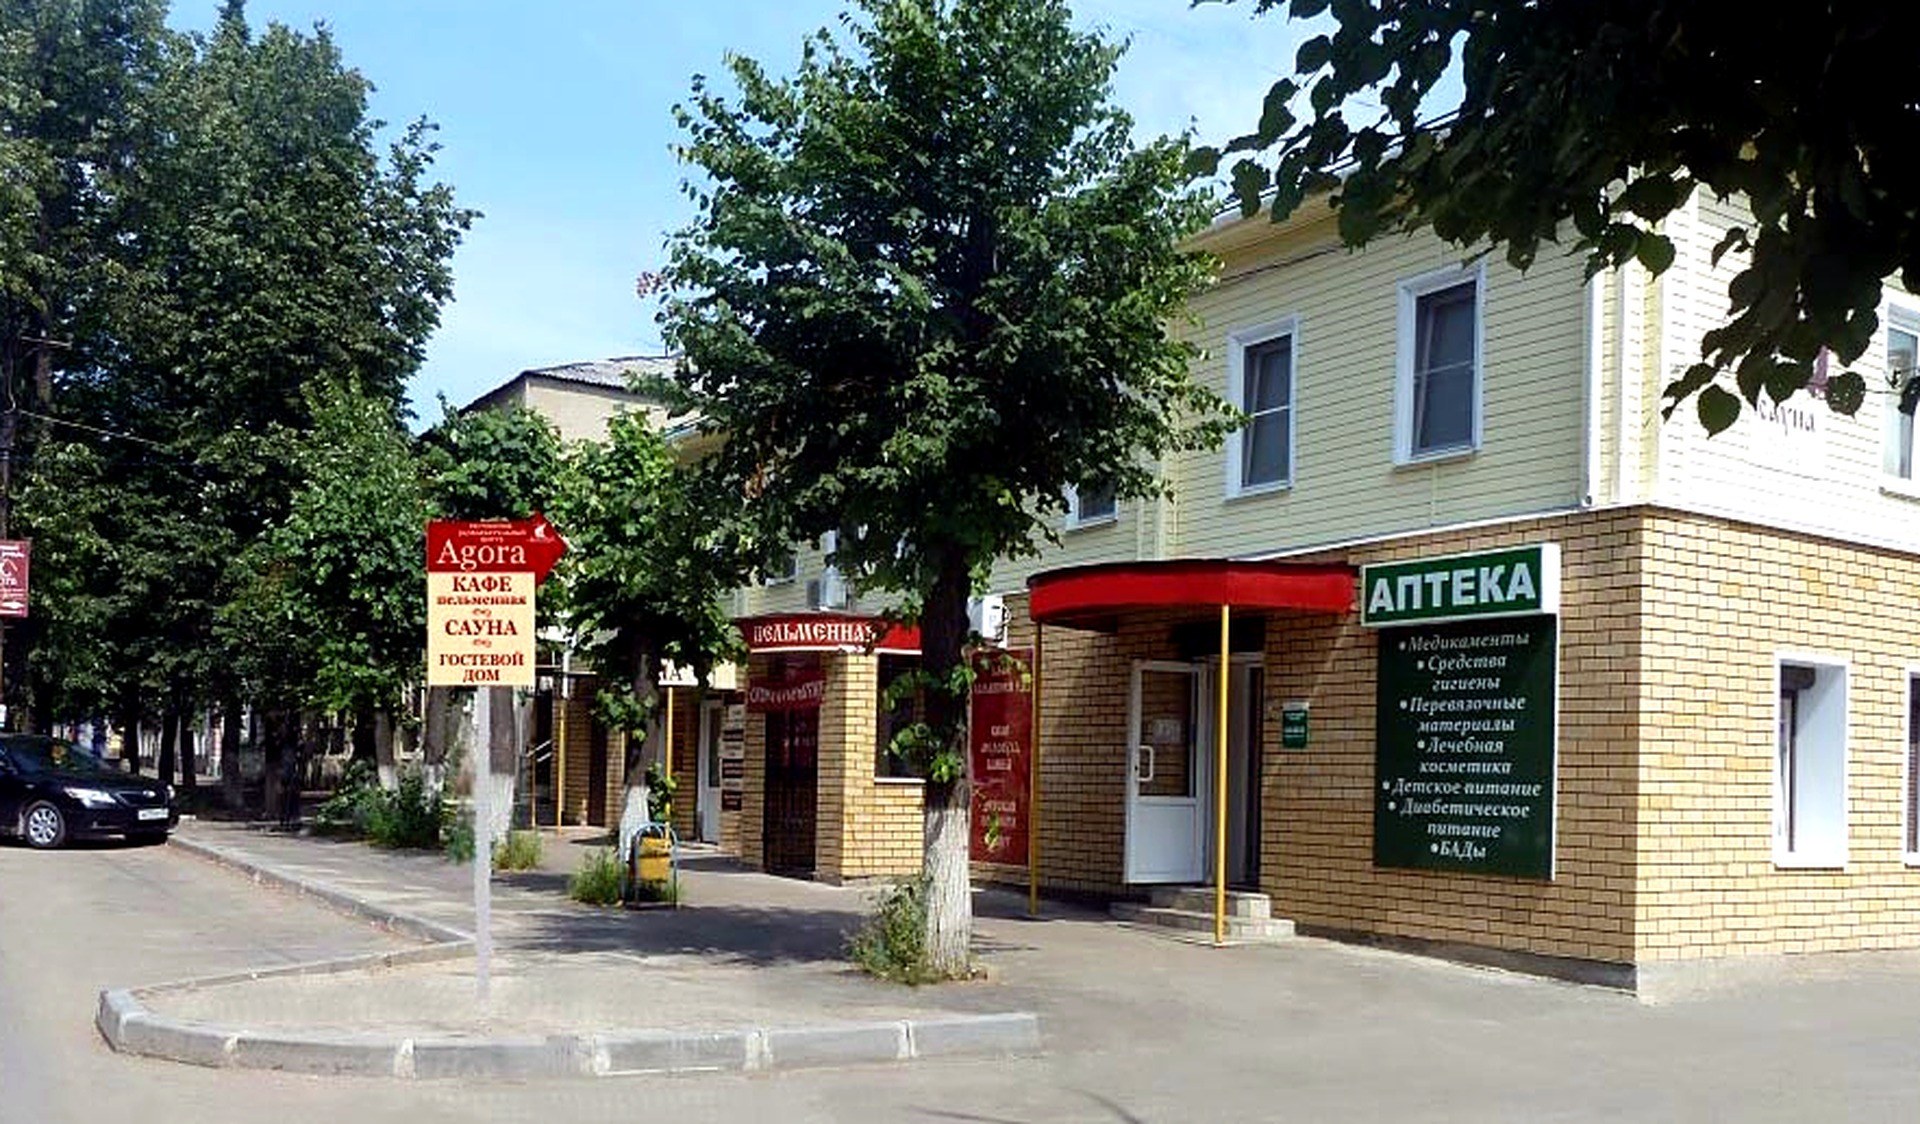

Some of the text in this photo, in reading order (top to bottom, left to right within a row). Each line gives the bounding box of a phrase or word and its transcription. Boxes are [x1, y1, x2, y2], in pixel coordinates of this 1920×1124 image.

[436, 538, 527, 572] Agora
[452, 575, 512, 592] КАФЕ
[1367, 561, 1537, 614] АПТЕКА
[437, 595, 527, 605] пельменная
[445, 619, 518, 635] САУНА
[1408, 633, 1530, 651] Медикаменты
[439, 651, 524, 666] ГОСТЕВОЙ
[1427, 653, 1507, 675] Средства
[463, 669, 499, 682] ДОМ
[1432, 677, 1501, 692] гигиены
[1409, 697, 1527, 716] Перевязочные
[1417, 718, 1515, 736] материалы
[1426, 736, 1504, 754] Лечебная
[1418, 761, 1513, 774] косметика
[1391, 777, 1543, 797] Детское питание
[1400, 797, 1530, 818] Диабетическое
[1427, 822, 1501, 838] питание
[1439, 841, 1487, 860] БАДы
